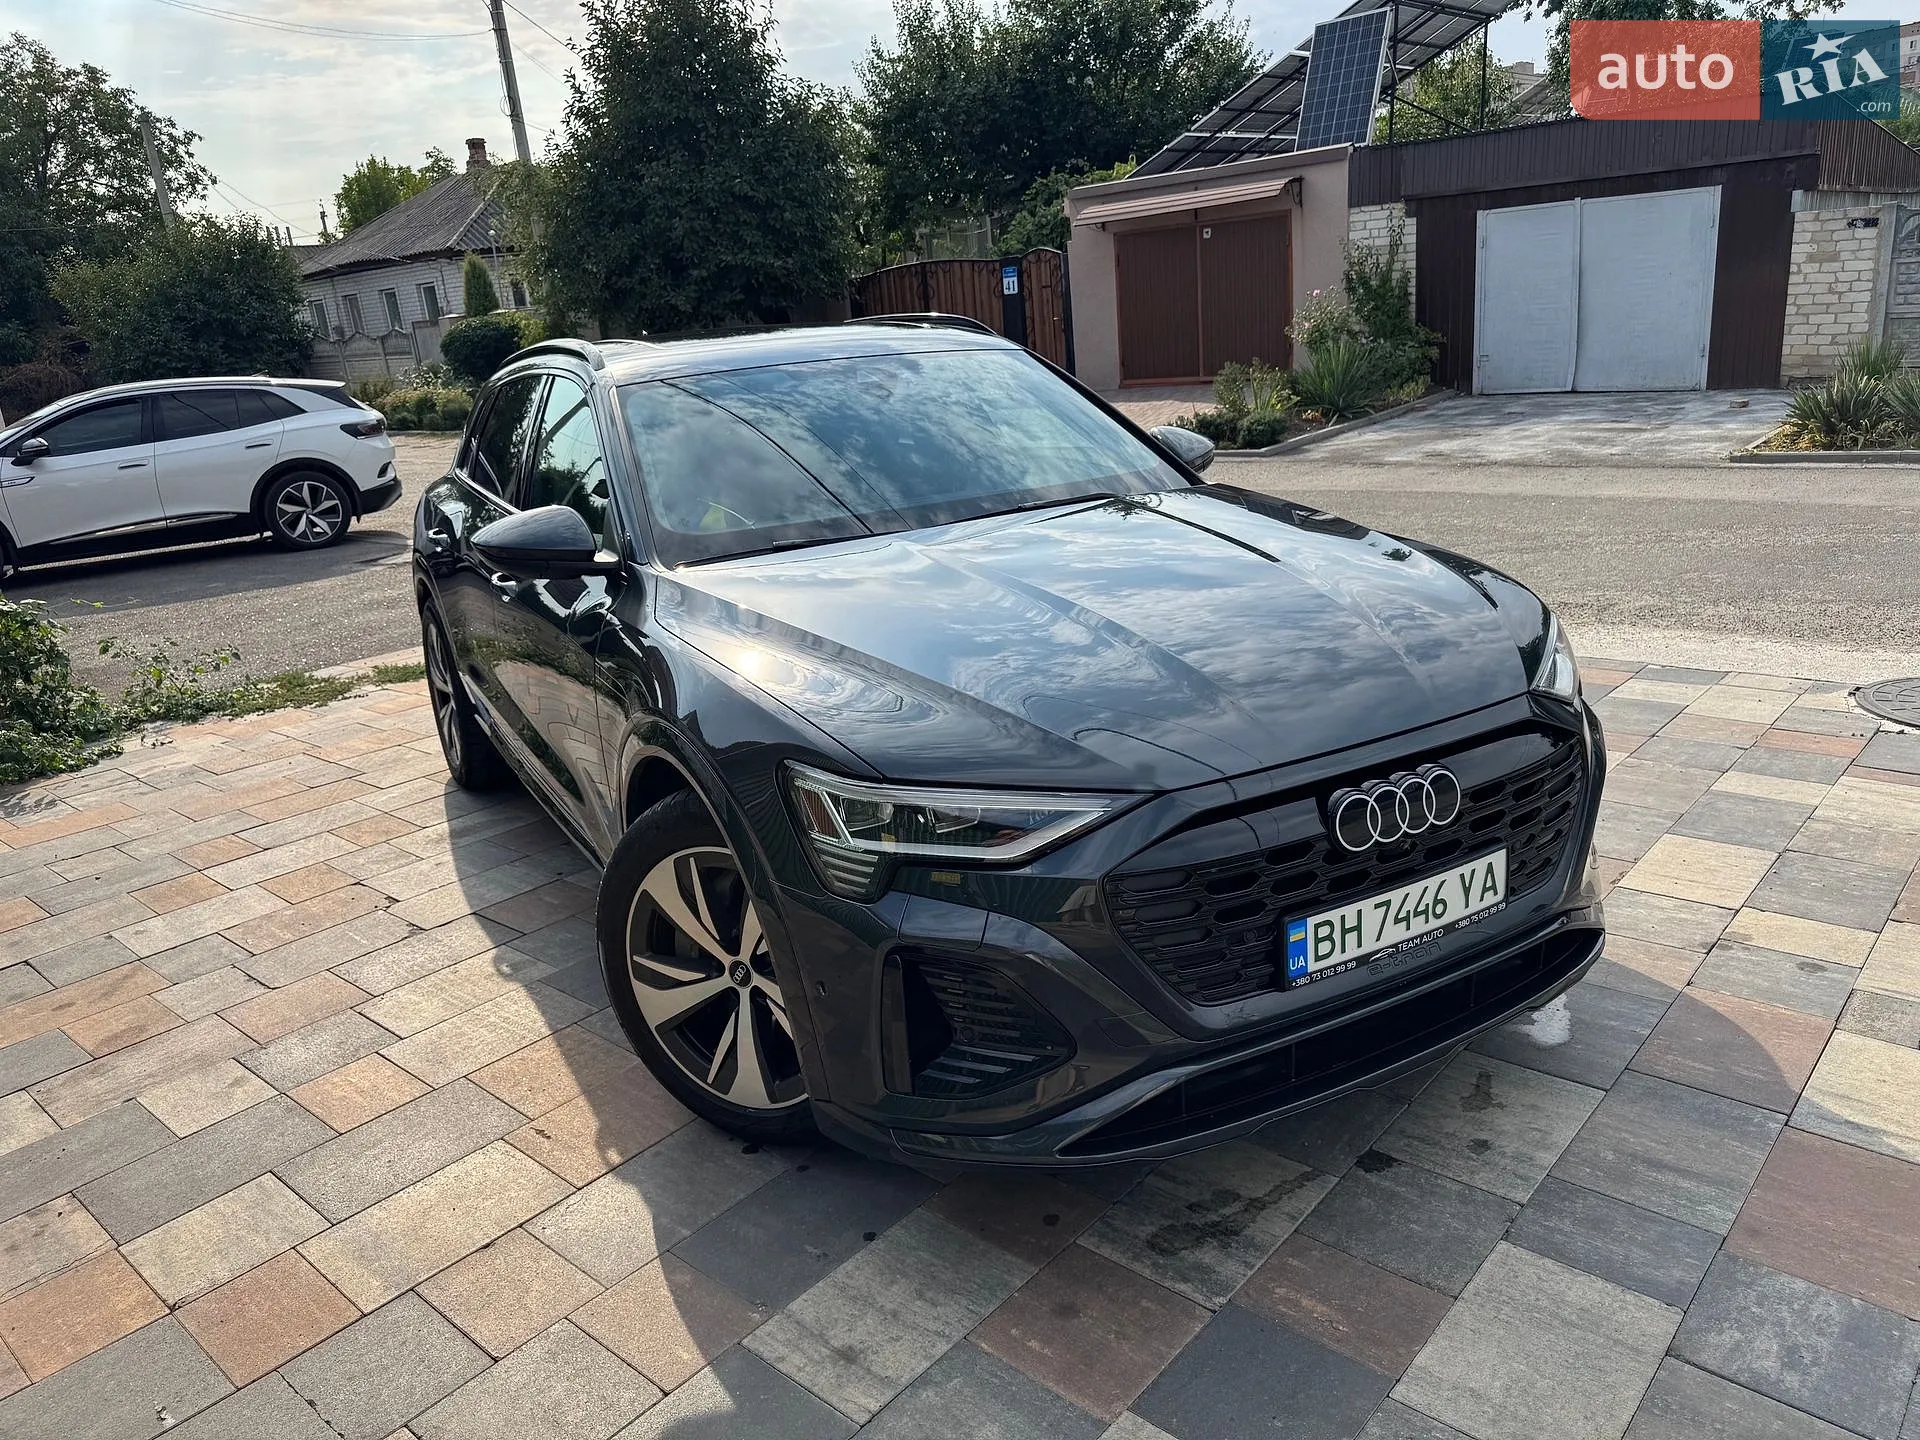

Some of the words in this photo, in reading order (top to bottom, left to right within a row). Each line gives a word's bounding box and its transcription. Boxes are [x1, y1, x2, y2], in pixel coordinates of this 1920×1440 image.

[1005, 280, 1015, 292] 41
[1313, 908, 1363, 963] BH
[1373, 879, 1448, 943] 7446
[1459, 861, 1499, 909] YA
[1455, 918, 1470, 929] +380
[1478, 910, 1489, 918] 012
[1490, 906, 1498, 915] 99
[1497, 902, 1506, 911] 99
[1397, 937, 1420, 952] TEAM
[1421, 928, 1444, 944] AUTO
[1289, 955, 1306, 970] UA
[1291, 976, 1310, 987] +380
[1311, 972, 1321, 981] 73
[1322, 968, 1335, 978] 012
[1335, 964, 1345, 974] 99
[1346, 960, 1356, 969] 99
